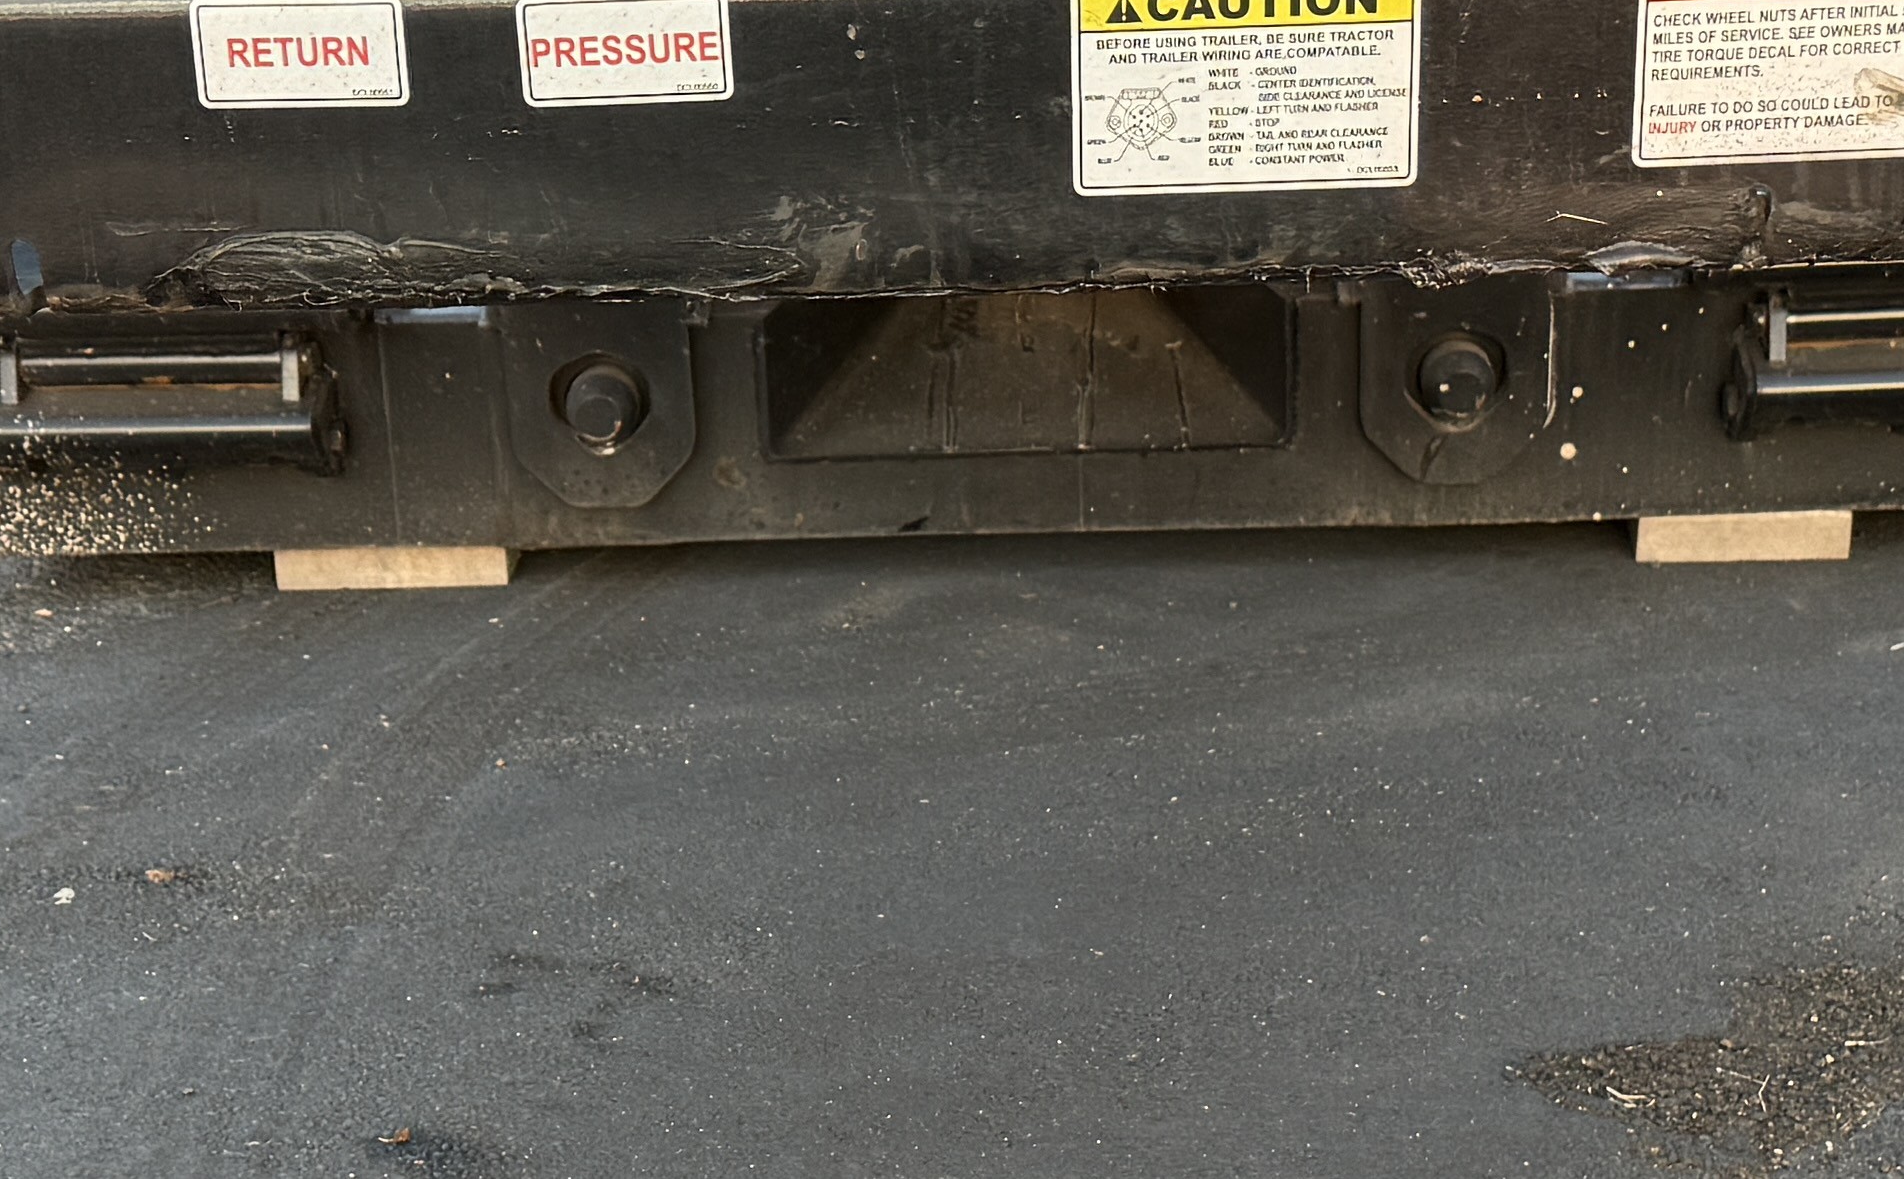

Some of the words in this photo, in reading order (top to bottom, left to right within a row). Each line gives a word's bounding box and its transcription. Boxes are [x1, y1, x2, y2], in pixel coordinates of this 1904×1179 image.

[1653, 12, 1702, 27] CHECK
[1706, 11, 1755, 24] WHEEL
[1759, 8, 1796, 23] NUTS
[1800, 6, 1845, 21] AFTER
[1850, 5, 1898, 18] INITIAL
[1096, 38, 1151, 50] BEFORE
[1155, 36, 1197, 48] USING
[1266, 33, 1284, 45] BE
[1289, 32, 1325, 44] SURE
[1330, 29, 1394, 42] TRACTOR
[1653, 31, 1694, 44] MILES
[1698, 30, 1716, 43] OF
[1721, 27, 1783, 42] SERVICE.
[1789, 26, 1815, 40] SEE
[1820, 23, 1882, 38] OWNERS
[227, 36, 369, 68] RETURN
[531, 31, 719, 68] PRESSURE
[1108, 53, 1137, 65] AND
[1141, 51, 1198, 64] TRAILER
[1202, 50, 1251, 62] WIRING
[1652, 50, 1682, 63] TIRE
[1687, 47, 1744, 62] TORQUE
[1748, 45, 1795, 59] DECAL
[1799, 44, 1828, 57] FOR
[1833, 40, 1901, 56] CORRECT
[1208, 68, 1239, 77] WHITE
[1255, 66, 1297, 76] GROUND
[1652, 64, 1764, 81] REQUIREMENTS.
[1208, 81, 1241, 90] BLACK
[1208, 106, 1249, 116] YELLOW
[1649, 102, 1706, 117] FAILURE
[1711, 102, 1729, 114] TO
[1733, 101, 1753, 114] DO
[1757, 100, 1777, 112] SO
[1781, 97, 1829, 111] COULD
[1834, 95, 1870, 109] LEAD
[1875, 94, 1894, 108] TO
[1648, 121, 1696, 134] INJURY
[1701, 119, 1721, 133] OR
[1725, 116, 1799, 131] PROPERTY
[1208, 132, 1245, 141] BROWN
